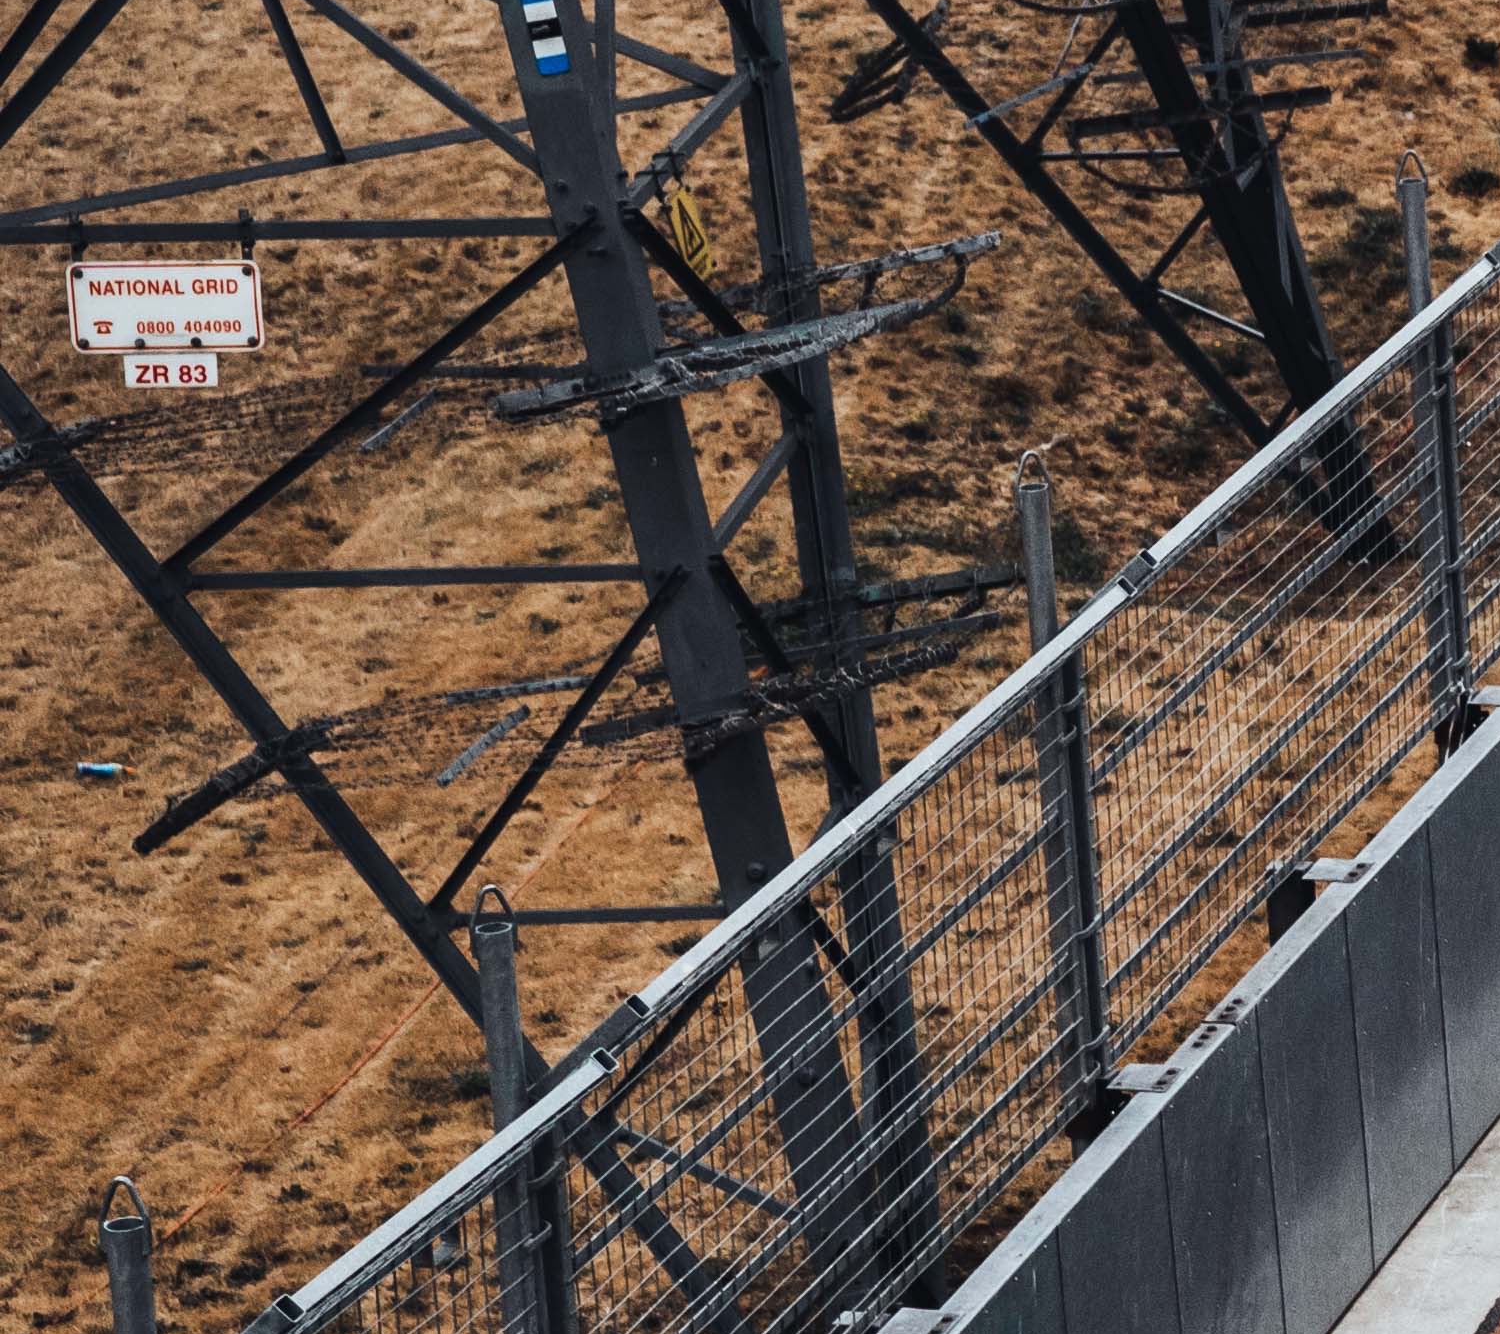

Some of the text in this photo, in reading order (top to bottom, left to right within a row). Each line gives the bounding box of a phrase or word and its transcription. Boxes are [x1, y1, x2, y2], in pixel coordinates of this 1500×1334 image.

[89, 279, 238, 296] NATIONAL GRID
[137, 320, 241, 334] 0800 404090
[135, 364, 207, 383] ZR 83
